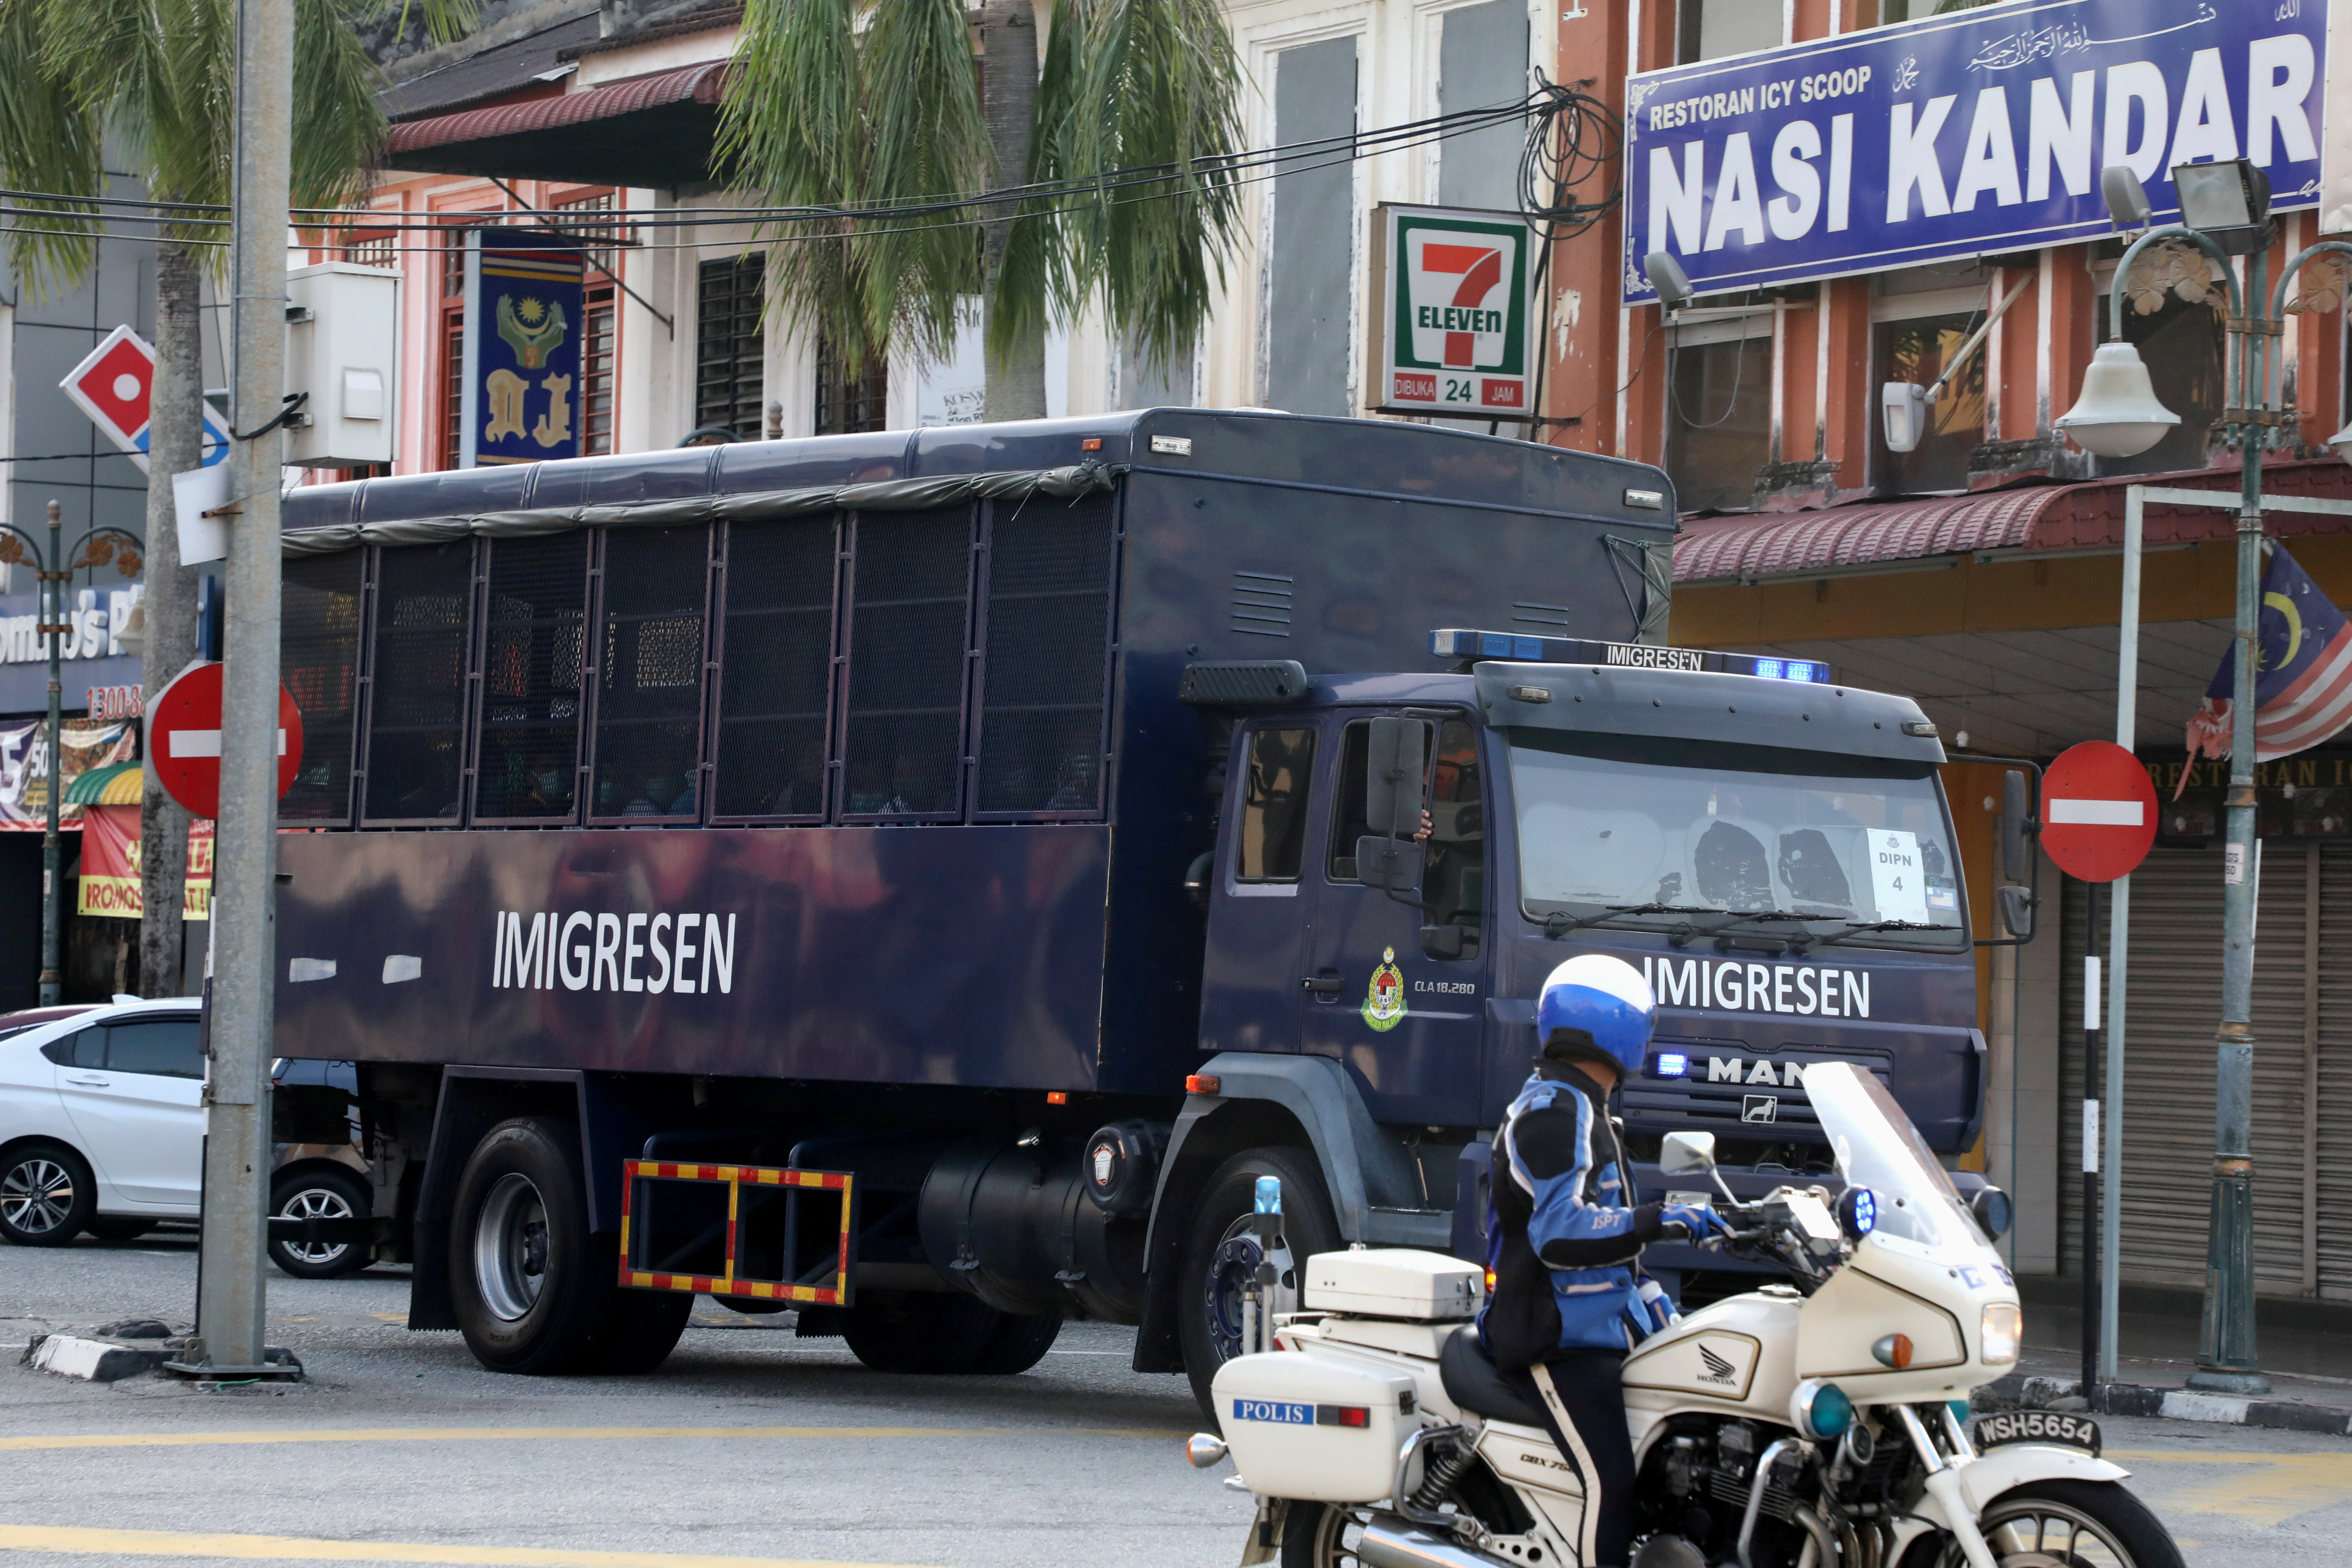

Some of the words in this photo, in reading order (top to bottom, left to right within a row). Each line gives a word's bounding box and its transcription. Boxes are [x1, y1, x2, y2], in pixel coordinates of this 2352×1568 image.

[1650, 87, 1754, 131] RESTORAN
[1760, 79, 1795, 111] ICY
[1800, 65, 1872, 103] SCOOP
[1648, 113, 1854, 255] NASI
[1886, 33, 2319, 224] KANDAR
[1395, 379, 1435, 397] DIBUKA
[1445, 379, 1472, 402] 24
[1491, 386, 1514, 402] JAM
[1607, 645, 1702, 671] IMIGRESEN
[2146, 759, 2317, 787] RESTRAN
[1879, 852, 1912, 867] DIPN
[1893, 876, 1904, 891] 4
[493, 910, 736, 994] IMIGRESEN
[1415, 981, 1435, 993] CLA
[1436, 982, 1475, 994] 18.280
[1644, 957, 1869, 1018] IMIGRESEN
[1708, 1056, 1810, 1086] MAN
[1592, 1214, 1621, 1231] JSPT
[1697, 1374, 1737, 1386] HONDA
[1242, 1401, 1304, 1423] POLIS
[1979, 1412, 2095, 1445] WSH5654
